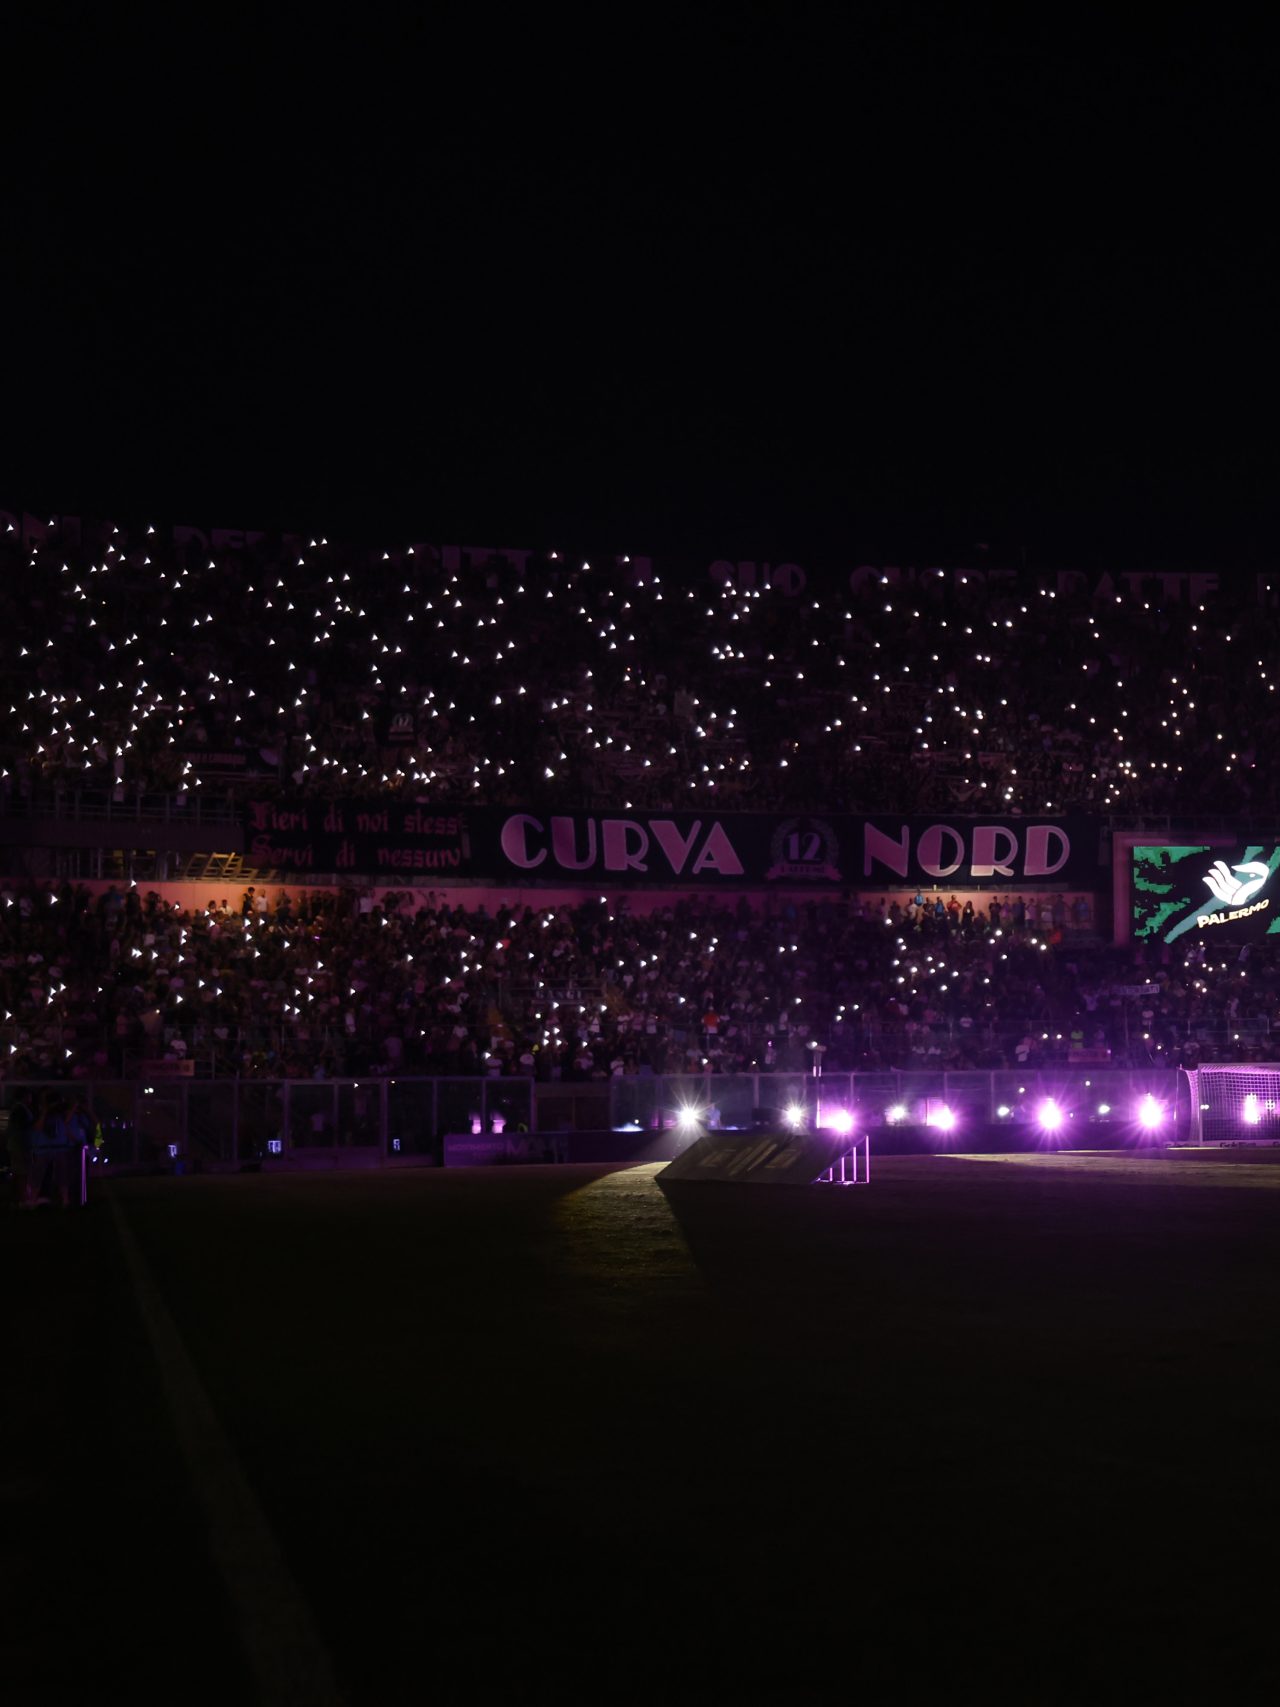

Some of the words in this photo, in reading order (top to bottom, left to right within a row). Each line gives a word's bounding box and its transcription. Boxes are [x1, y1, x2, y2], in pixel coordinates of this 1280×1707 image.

[323, 802, 345, 833] di
[336, 840, 356, 868] di
[499, 813, 745, 876] CURVA
[788, 830, 822, 862] 12
[862, 823, 1071, 878] NORD
[1196, 898, 1270, 928] PALERMO
